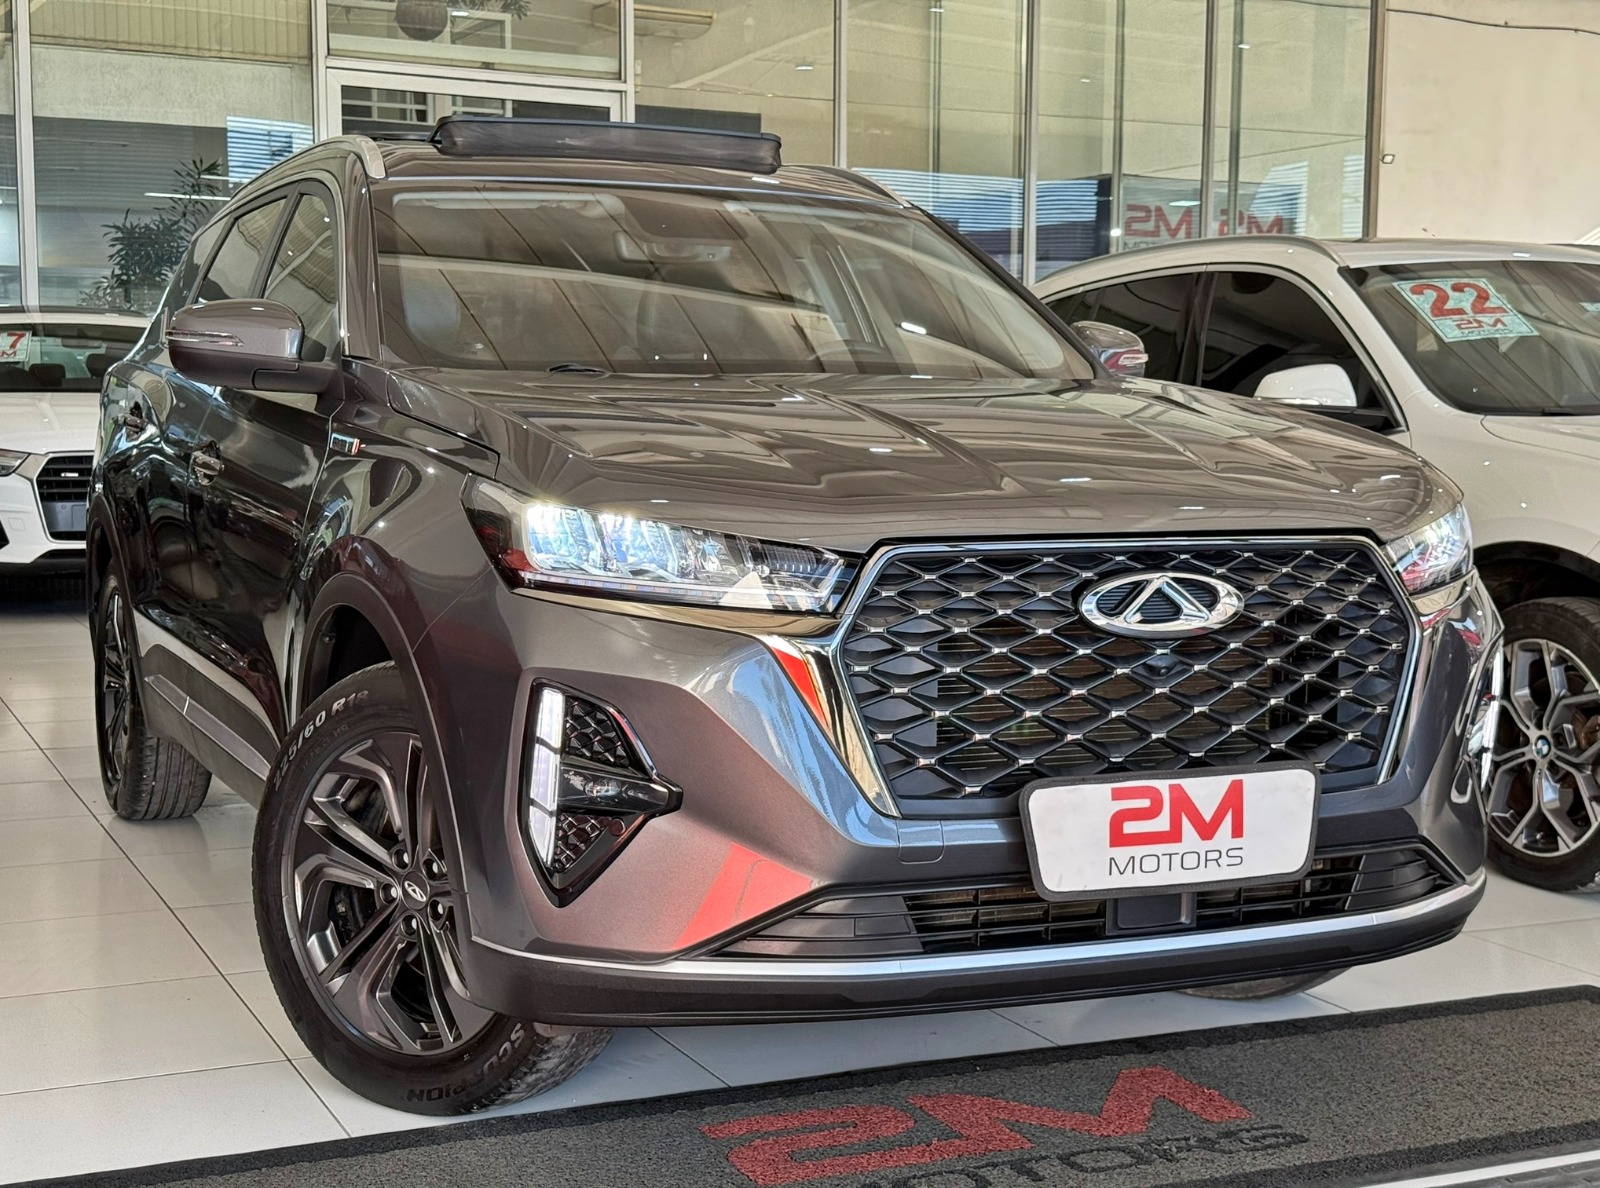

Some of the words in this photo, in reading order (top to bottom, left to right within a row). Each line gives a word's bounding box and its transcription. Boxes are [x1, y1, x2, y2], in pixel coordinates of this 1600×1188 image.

[1124, 204, 1194, 239] 2M
[1409, 282, 1509, 318] 22
[1452, 318, 1508, 331] 2M
[0, 350, 17, 358] M
[273, 710, 327, 793] 225/60
[1109, 779, 1244, 848] 2M
[1109, 847, 1244, 876] MOTORS
[699, 1065, 1254, 1186] 2M
[862, 1124, 1309, 1188] OTORS
